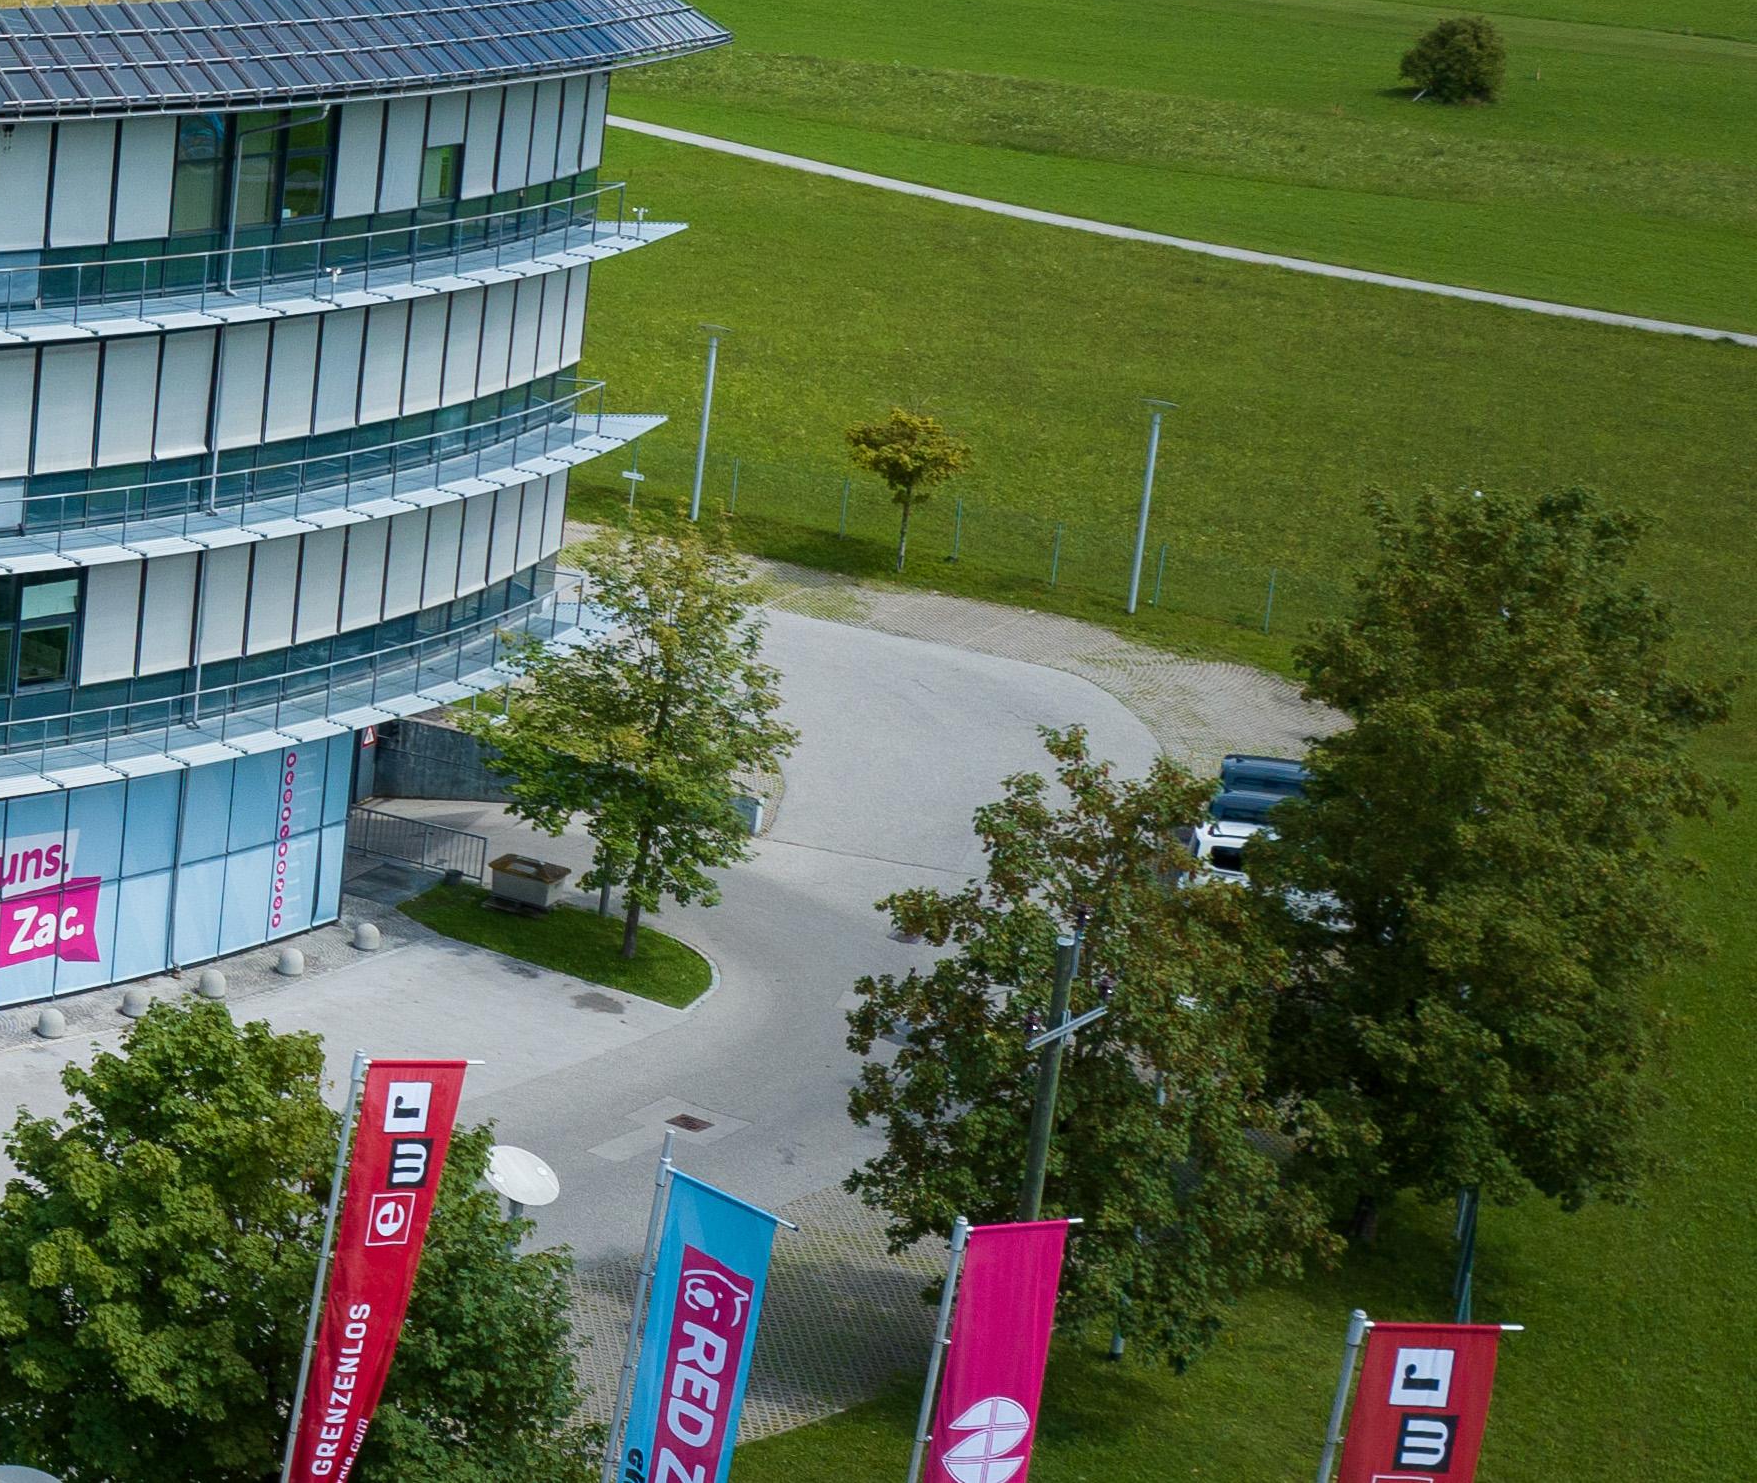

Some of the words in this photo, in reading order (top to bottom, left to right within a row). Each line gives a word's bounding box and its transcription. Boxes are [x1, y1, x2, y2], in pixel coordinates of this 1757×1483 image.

[9, 906, 85, 955] Zac.
[375, 1095, 427, 1237] ewr
[311, 1303, 371, 1476] GRENZENLOS
[666, 1320, 728, 1448] RED
